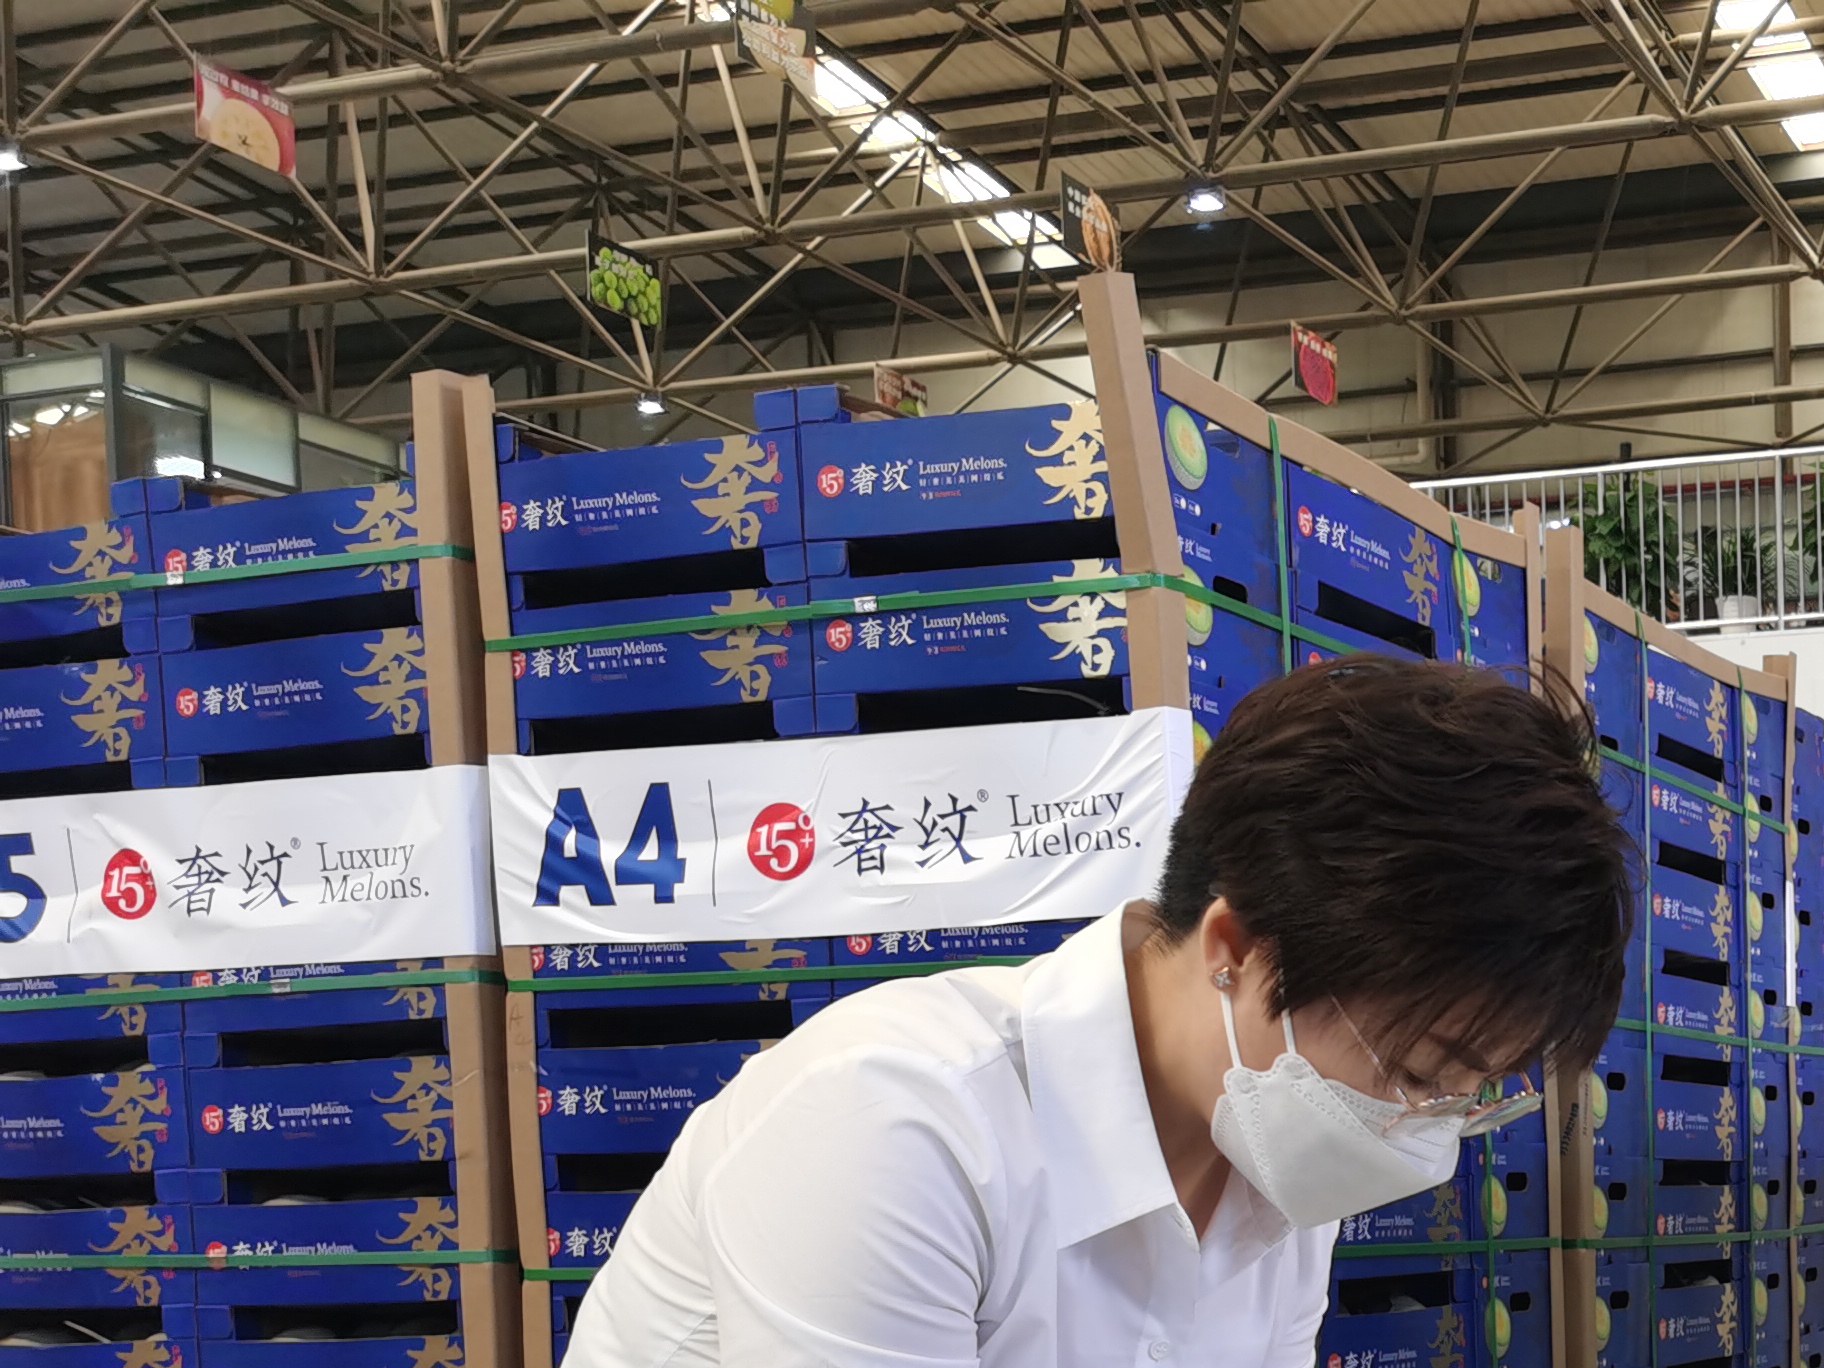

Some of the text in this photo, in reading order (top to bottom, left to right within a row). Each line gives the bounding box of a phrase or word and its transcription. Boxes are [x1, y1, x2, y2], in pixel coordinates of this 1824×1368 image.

[849, 462, 912, 495] 奢纹
[918, 459, 960, 477] Luxury
[961, 457, 1007, 471] Melons.
[520, 497, 567, 529] 奢纹
[572, 496, 612, 512] Luxury
[613, 492, 660, 508] Melons.
[244, 541, 277, 554] Luxury
[278, 536, 316, 550] Melons.
[1314, 514, 1348, 551] 奢纹
[857, 616, 916, 649] 奢纹
[922, 616, 962, 632] Luxury
[963, 611, 1009, 627] Melons.
[530, 641, 667, 679] 奢纹 Luxury Melons.
[201, 684, 249, 715] 奢纹
[252, 683, 288, 697] Luxury
[288, 679, 323, 693] Melons.
[1006, 792, 1124, 830] Luxury
[318, 842, 414, 875] Luxury
[533, 782, 686, 907] A4
[1006, 825, 1141, 858] Melons.
[319, 873, 429, 903] Melons.
[227, 1104, 272, 1133] 奢纹
[277, 1104, 309, 1117] Luxury
[311, 1102, 352, 1116] Melons.
[556, 1084, 609, 1116] 奢纹
[613, 1088, 646, 1101] Luxury
[649, 1085, 696, 1099] Melons.
